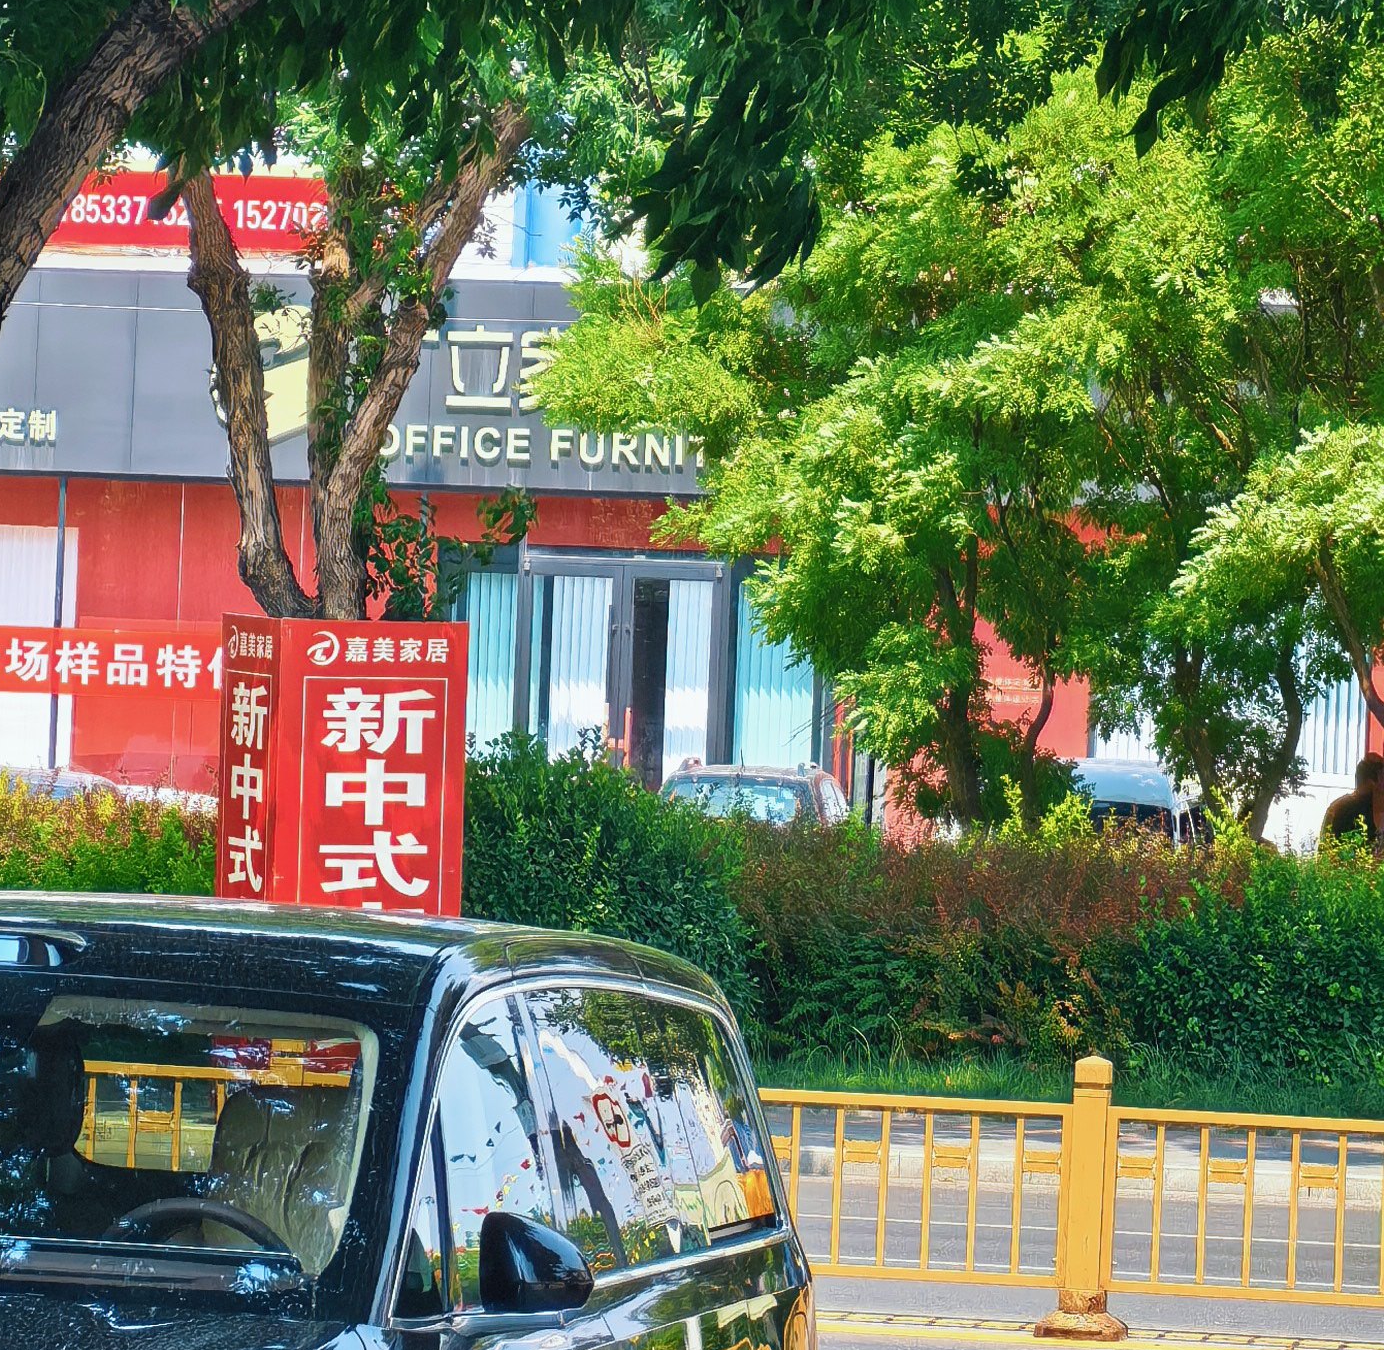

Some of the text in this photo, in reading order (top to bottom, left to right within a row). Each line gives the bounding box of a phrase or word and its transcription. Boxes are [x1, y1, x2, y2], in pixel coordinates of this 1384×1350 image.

[345, 636, 450, 663] 嘉美家居
[227, 681, 268, 893] 新中式
[319, 687, 436, 914] 新中式
